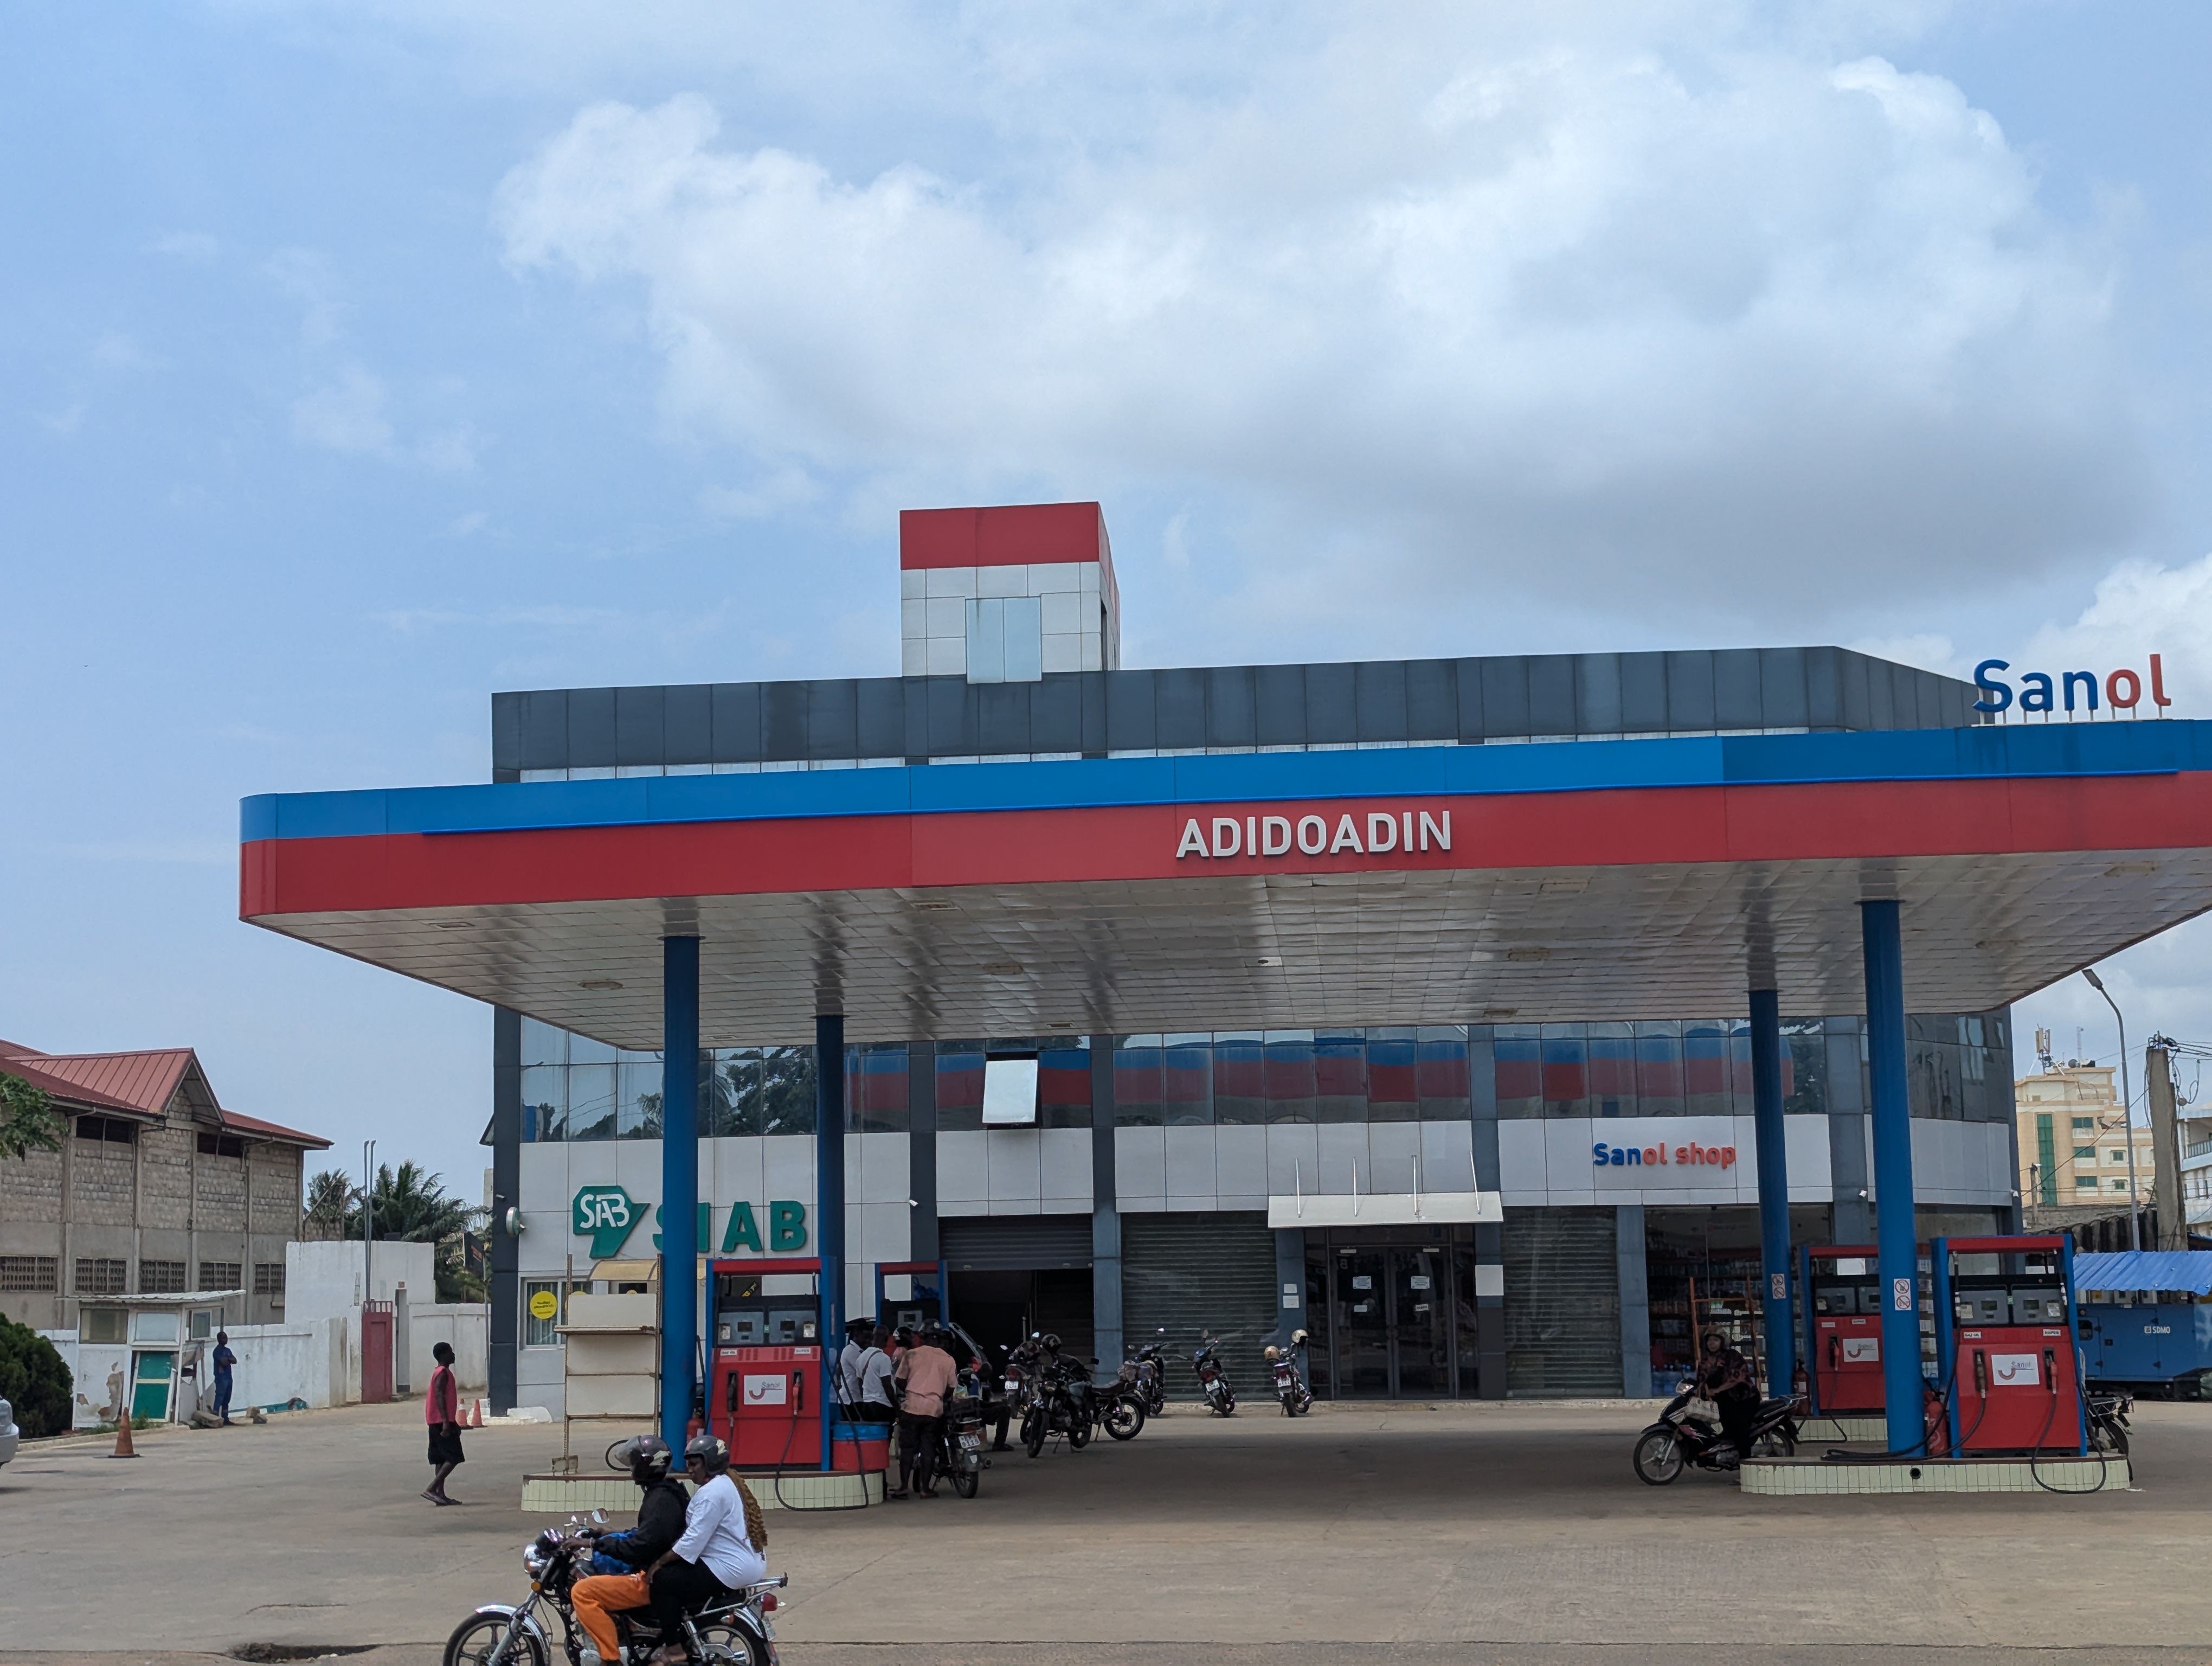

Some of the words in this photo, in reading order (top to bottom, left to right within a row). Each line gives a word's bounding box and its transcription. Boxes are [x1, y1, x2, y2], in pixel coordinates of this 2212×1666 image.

[1972, 653, 2171, 713] Sanol
[1176, 810, 1451, 858] ADIDOADIN
[1593, 1142, 1668, 1166] Sanol
[1675, 1142, 1735, 1169] shop
